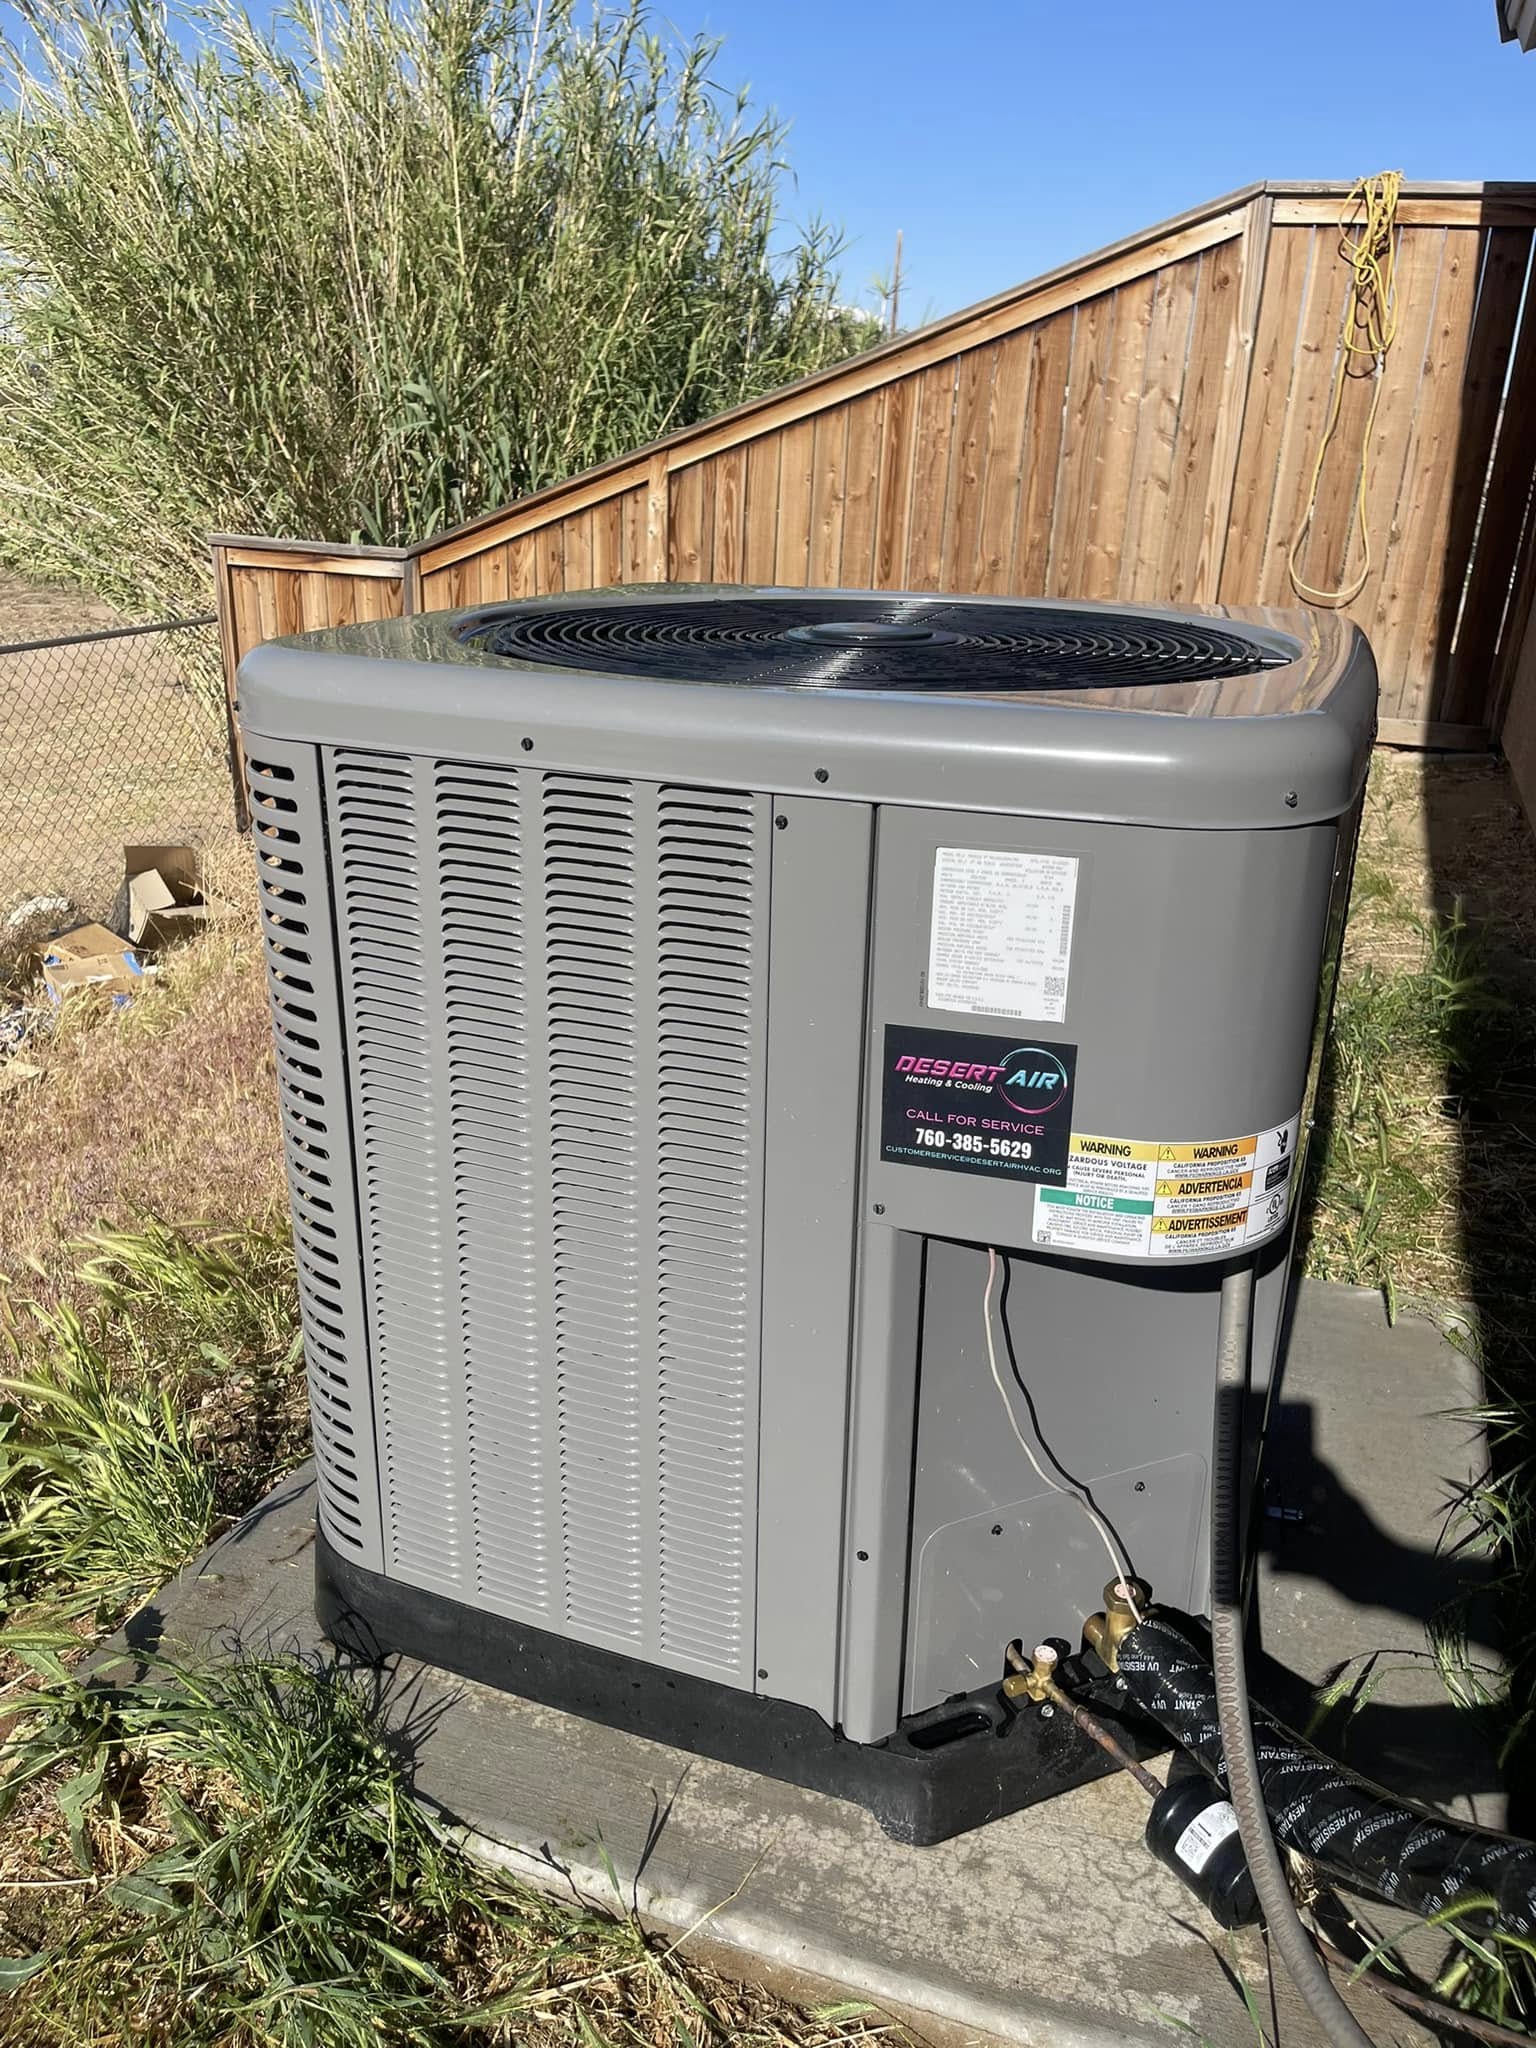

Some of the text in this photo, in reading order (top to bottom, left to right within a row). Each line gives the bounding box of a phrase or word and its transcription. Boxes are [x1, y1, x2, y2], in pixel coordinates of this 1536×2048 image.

[895, 1055, 1061, 1090] DESERT AIR
[905, 1074, 994, 1094] Heating & Cooling
[906, 1109, 1045, 1136] CALL FOR SERVICE
[915, 1127, 1032, 1160] 760-385-5629
[1080, 1140, 1132, 1157] WARNING
[1193, 1143, 1238, 1159] WARNING
[1069, 1155, 1108, 1166] ZARDOUS
[1111, 1160, 1148, 1171] VOLTAGE
[1071, 1164, 1091, 1172] CAUSE
[1092, 1166, 1112, 1174] SEVERE
[1114, 1169, 1145, 1178] PERSONAL
[1173, 1161, 1206, 1169] CALIFORNIA
[1207, 1158, 1239, 1167] PROPOSITION
[1178, 1176, 1243, 1195] ADVERTENCIA
[1075, 1194, 1115, 1209] NOTICE
[1169, 1196, 1202, 1204] CALIFORNIA
[1203, 1193, 1235, 1203] PROPOSITION
[1168, 1210, 1248, 1231] ADVERTISSEMENT
[1198, 1229, 1230, 1238] PROPOSITION
[1147, 1662, 1159, 1672] UV
[1397, 1811, 1413, 1822] UV
[1310, 1809, 1362, 1854] UV RESISTANT
[1431, 1828, 1447, 1842] UV
